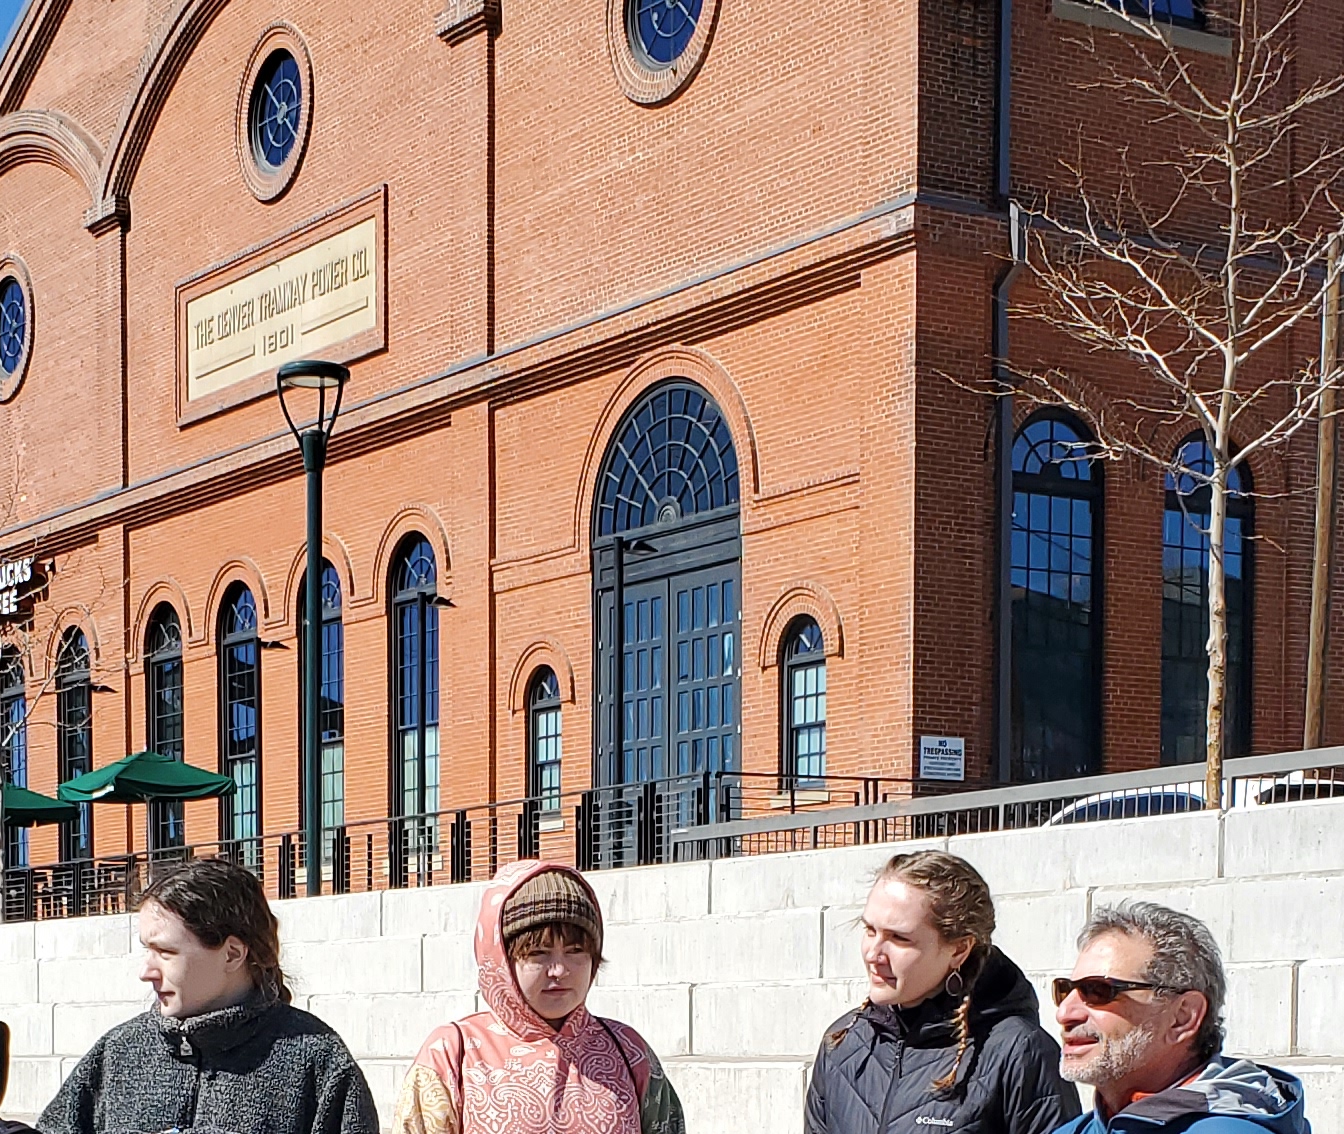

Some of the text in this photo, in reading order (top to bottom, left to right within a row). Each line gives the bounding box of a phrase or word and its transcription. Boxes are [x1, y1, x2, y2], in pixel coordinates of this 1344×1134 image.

[194, 247, 370, 350] THE DENVER TRAMWAY POWER CO.
[262, 323, 295, 356] 1901
